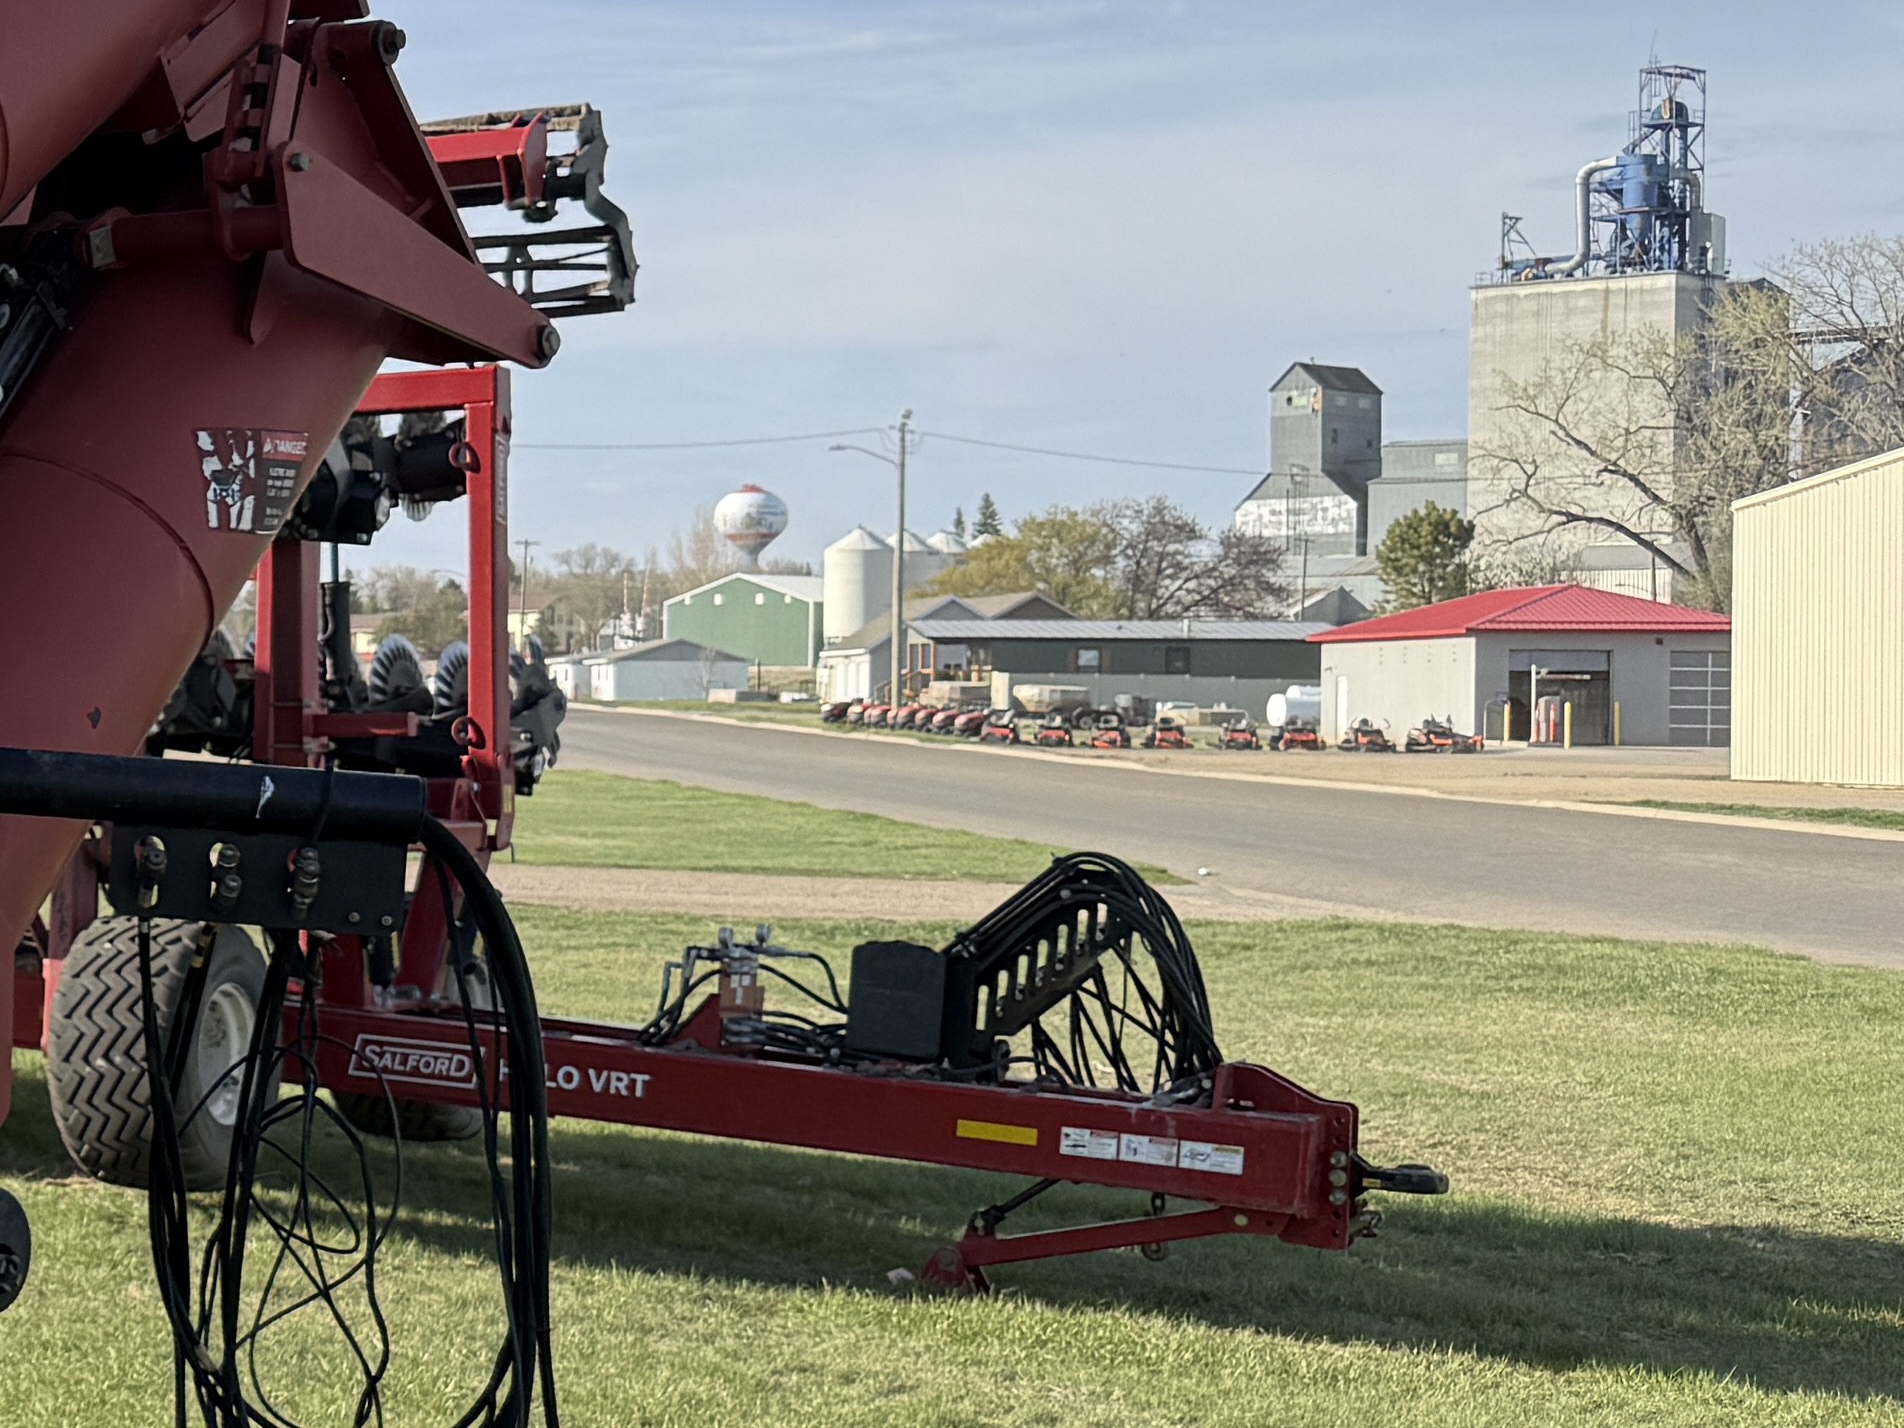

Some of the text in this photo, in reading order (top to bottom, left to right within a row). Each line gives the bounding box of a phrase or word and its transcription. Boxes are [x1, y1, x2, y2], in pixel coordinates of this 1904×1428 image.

[362, 1044, 651, 1098] SALFORD HLO VRT
